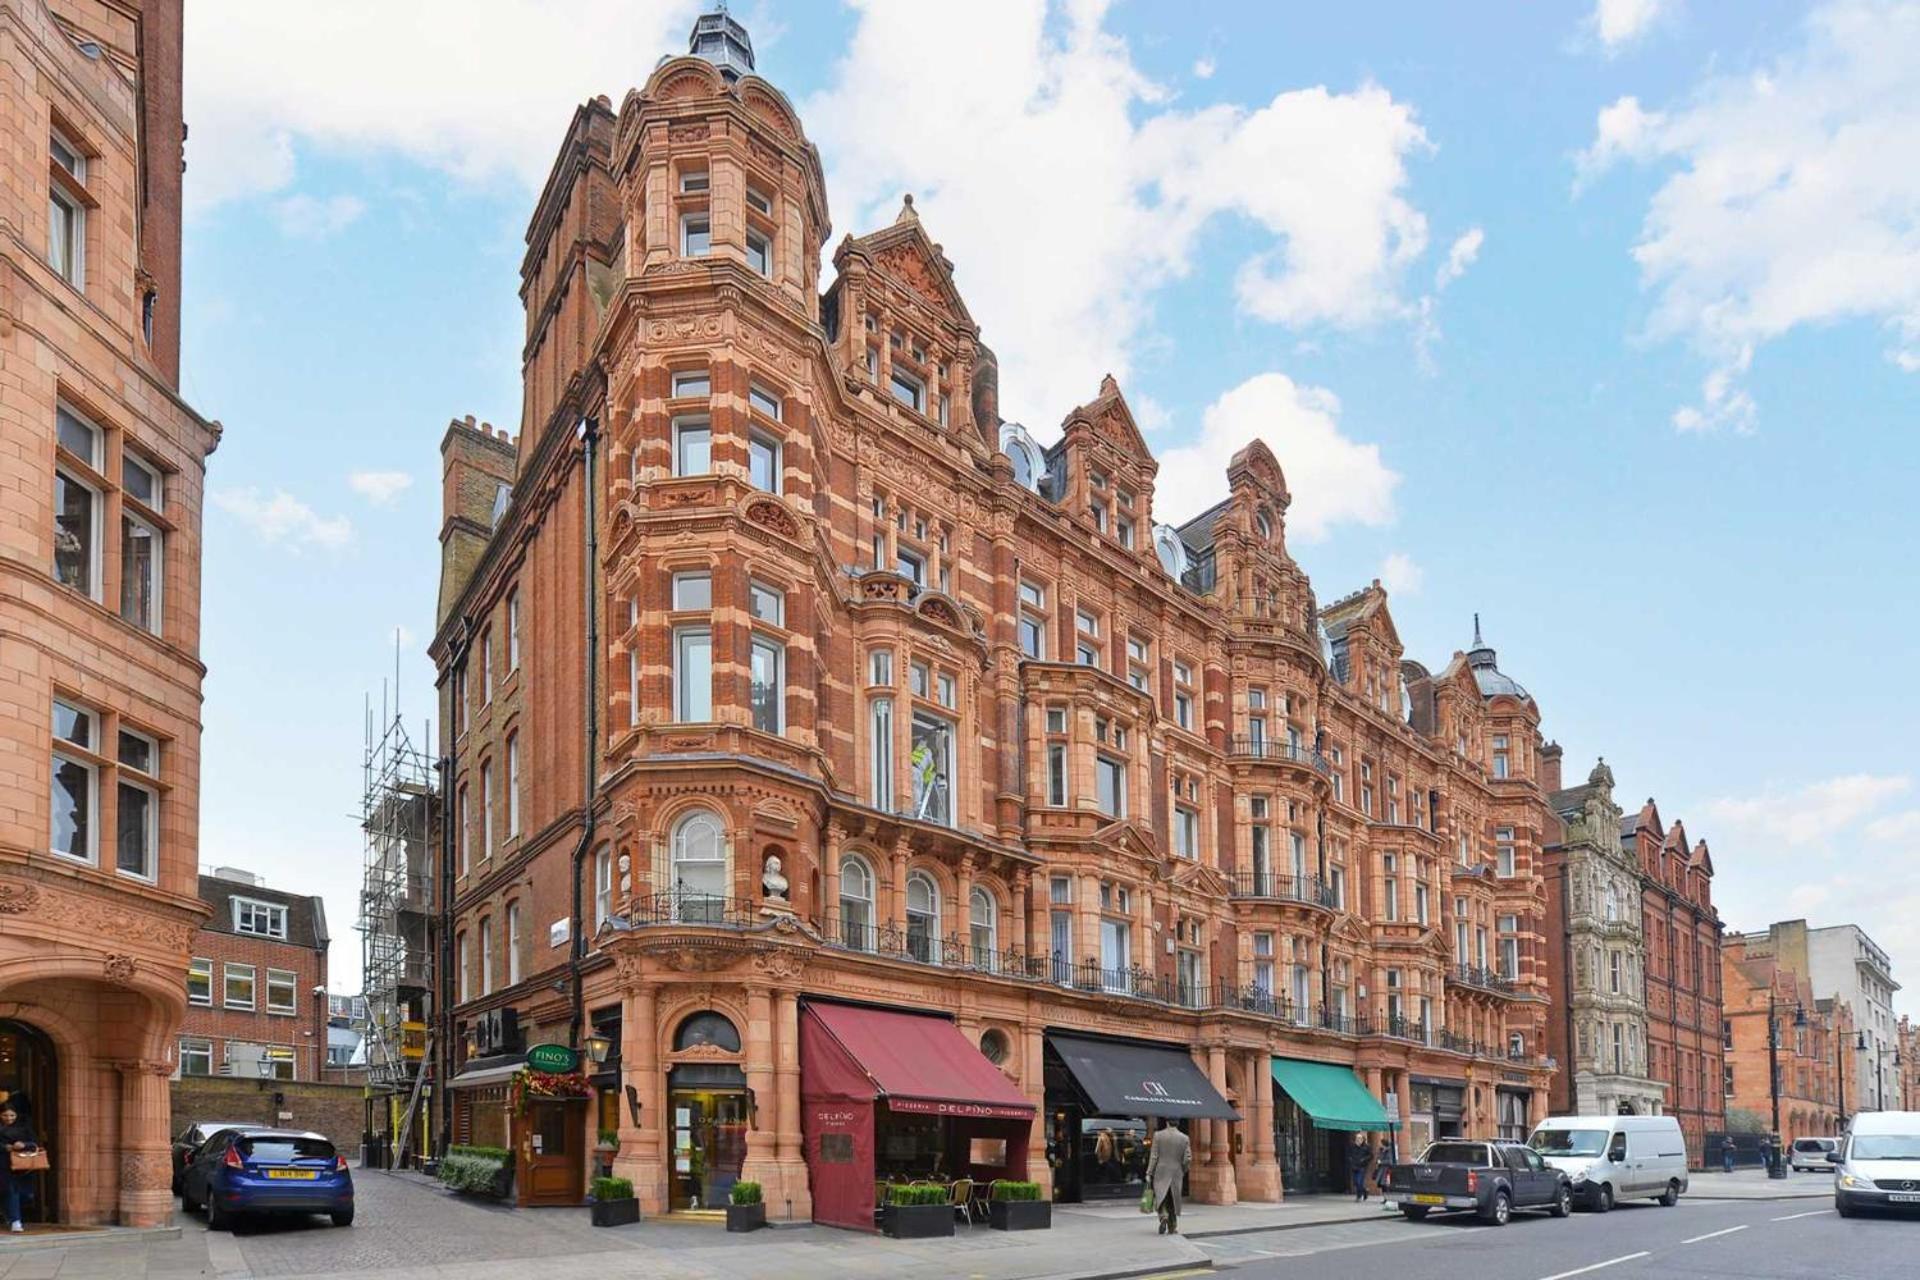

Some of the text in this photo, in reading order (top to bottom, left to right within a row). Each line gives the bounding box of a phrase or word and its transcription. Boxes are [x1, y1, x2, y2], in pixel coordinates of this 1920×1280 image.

[535, 1051, 570, 1063] FINO'S
[938, 1103, 993, 1115] DELFINO
[818, 1111, 854, 1121] DELFINO
